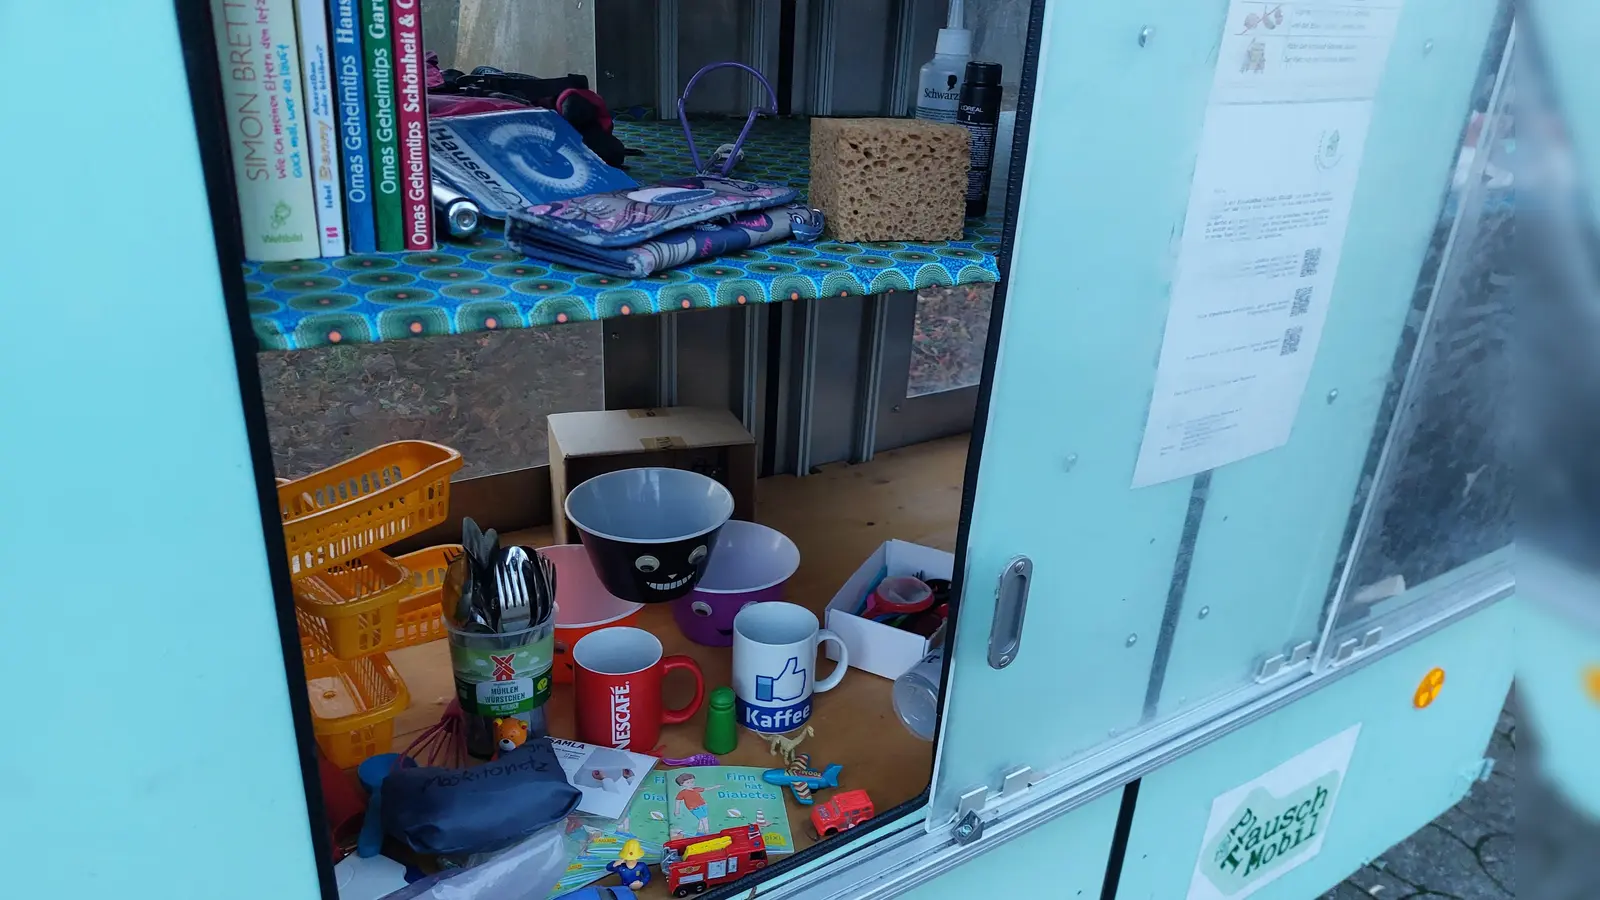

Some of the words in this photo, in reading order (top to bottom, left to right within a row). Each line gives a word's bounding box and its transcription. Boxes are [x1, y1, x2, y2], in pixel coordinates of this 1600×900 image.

[223, 0, 256, 81] BRETT
[398, 13, 415, 28] &
[372, 47, 393, 142] Geheimtips
[399, 31, 420, 113] Schönheit
[924, 87, 960, 101] Schwarz
[340, 55, 362, 151] Geheimtips
[235, 93, 269, 181] SIMON
[406, 121, 425, 201] Geheimtips
[348, 154, 366, 203] Omas
[380, 146, 397, 194] Omas
[411, 204, 428, 245] Omas
[746, 703, 811, 729] Kaffee
[717, 791, 777, 800] Diabetes
[726, 772, 756, 782] Finn
[744, 782, 763, 790] hat
[1243, 812, 1320, 877] Mobil
